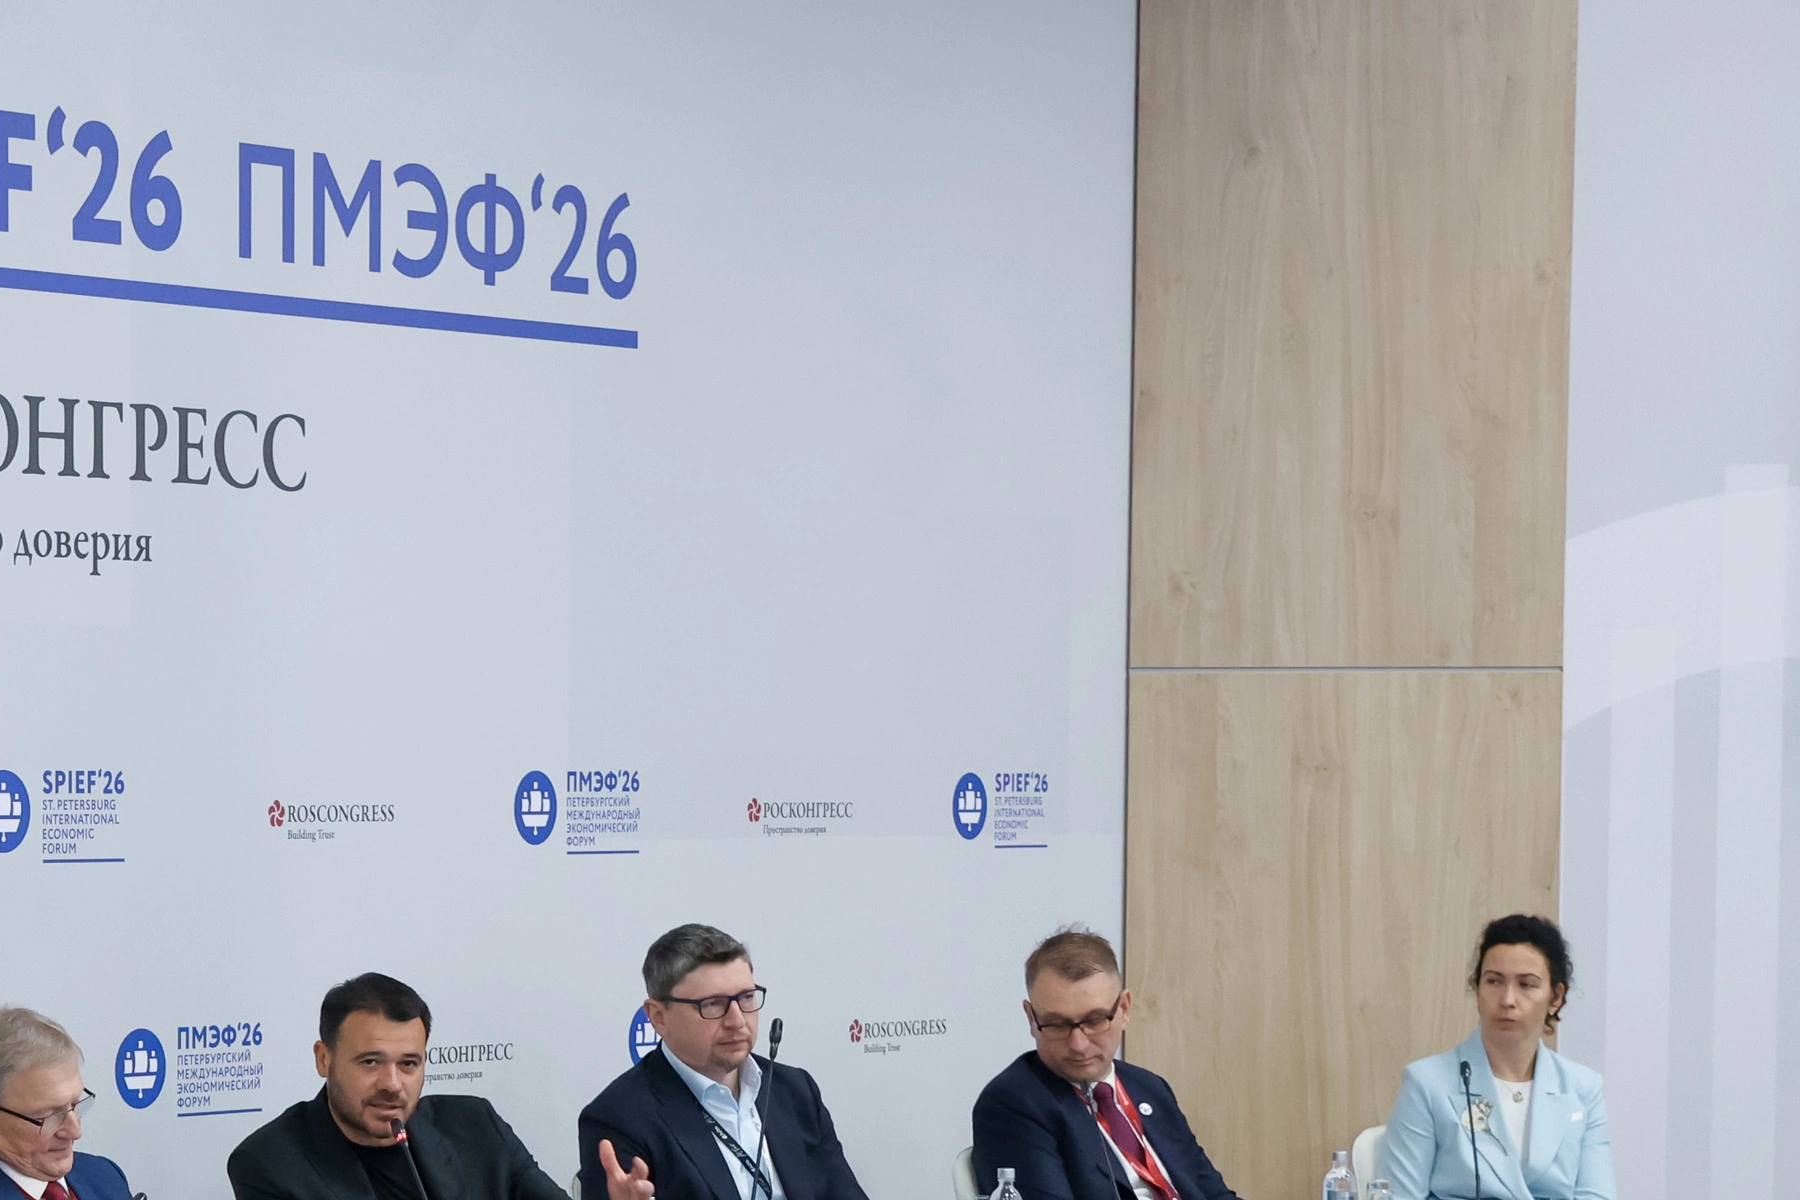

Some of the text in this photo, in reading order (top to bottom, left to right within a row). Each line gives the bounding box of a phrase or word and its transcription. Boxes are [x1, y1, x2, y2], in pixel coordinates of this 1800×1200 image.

[13, 528, 153, 576] доверия
[43, 800, 116, 811] ST. PETERSBURG
[567, 795, 630, 807] ПЕТЕРБУРГСКИЙ
[1004, 797, 1042, 806] PETERSBURG
[287, 804, 394, 823] ROSCONGRESS
[567, 807, 641, 822] МЕЖДУНАРОДНЫЙ
[764, 802, 853, 818] РОСКОНГРЕСС
[995, 808, 1044, 818] INTERNATIONAL
[43, 814, 119, 826] INTERNATIONAL
[995, 820, 1028, 829] ECONOMIC
[567, 820, 638, 834] ЭКОНОМИЧЕСКИЙ
[43, 829, 94, 840] ECONOMIC
[287, 829, 335, 842] Building Trust
[566, 835, 595, 847] ФОРУМ
[994, 831, 1016, 841] FORUM
[43, 842, 76, 854] FORUM
[864, 1019, 946, 1038] ROSCONGRESS
[177, 1050, 251, 1066] ПЕТЕРБУРГСКИЙ
[424, 1043, 513, 1064] СКОНГРЕСС
[177, 1062, 263, 1080] МЕЖДУНАРОДНЫЙ
[177, 1077, 261, 1094] ЭКОНОМИЧЕСКИЙ
[177, 1094, 210, 1108] ФОРУМ
